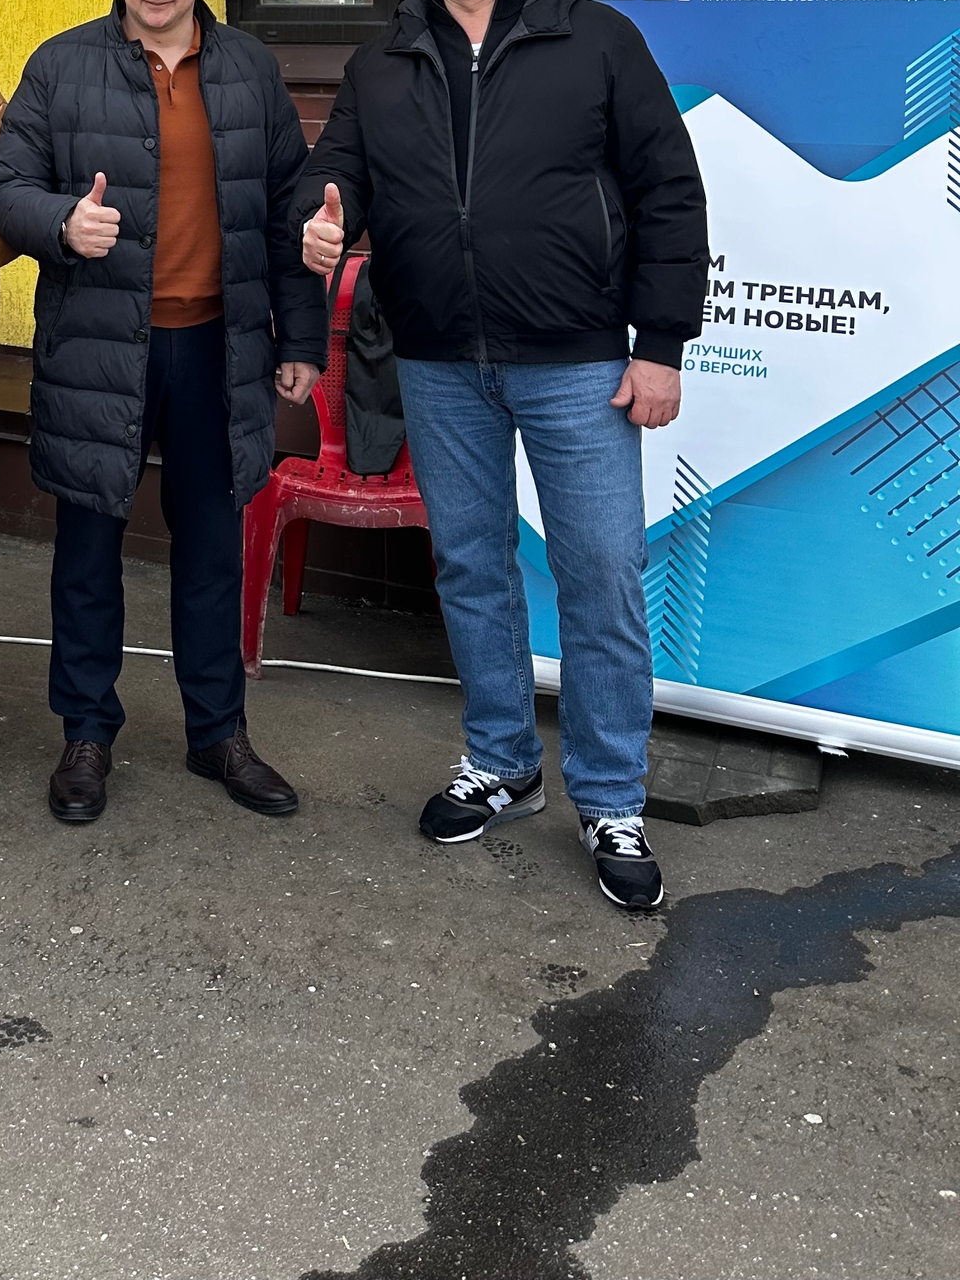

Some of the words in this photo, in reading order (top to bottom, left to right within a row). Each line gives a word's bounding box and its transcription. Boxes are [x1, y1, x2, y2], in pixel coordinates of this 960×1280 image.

[742, 281, 890, 315] ТРЕНДАМ,
[743, 308, 855, 335] НОВЫЕ!
[689, 343, 763, 362] ЛУЧШИХ
[700, 360, 768, 378] ВЕРСИИ
